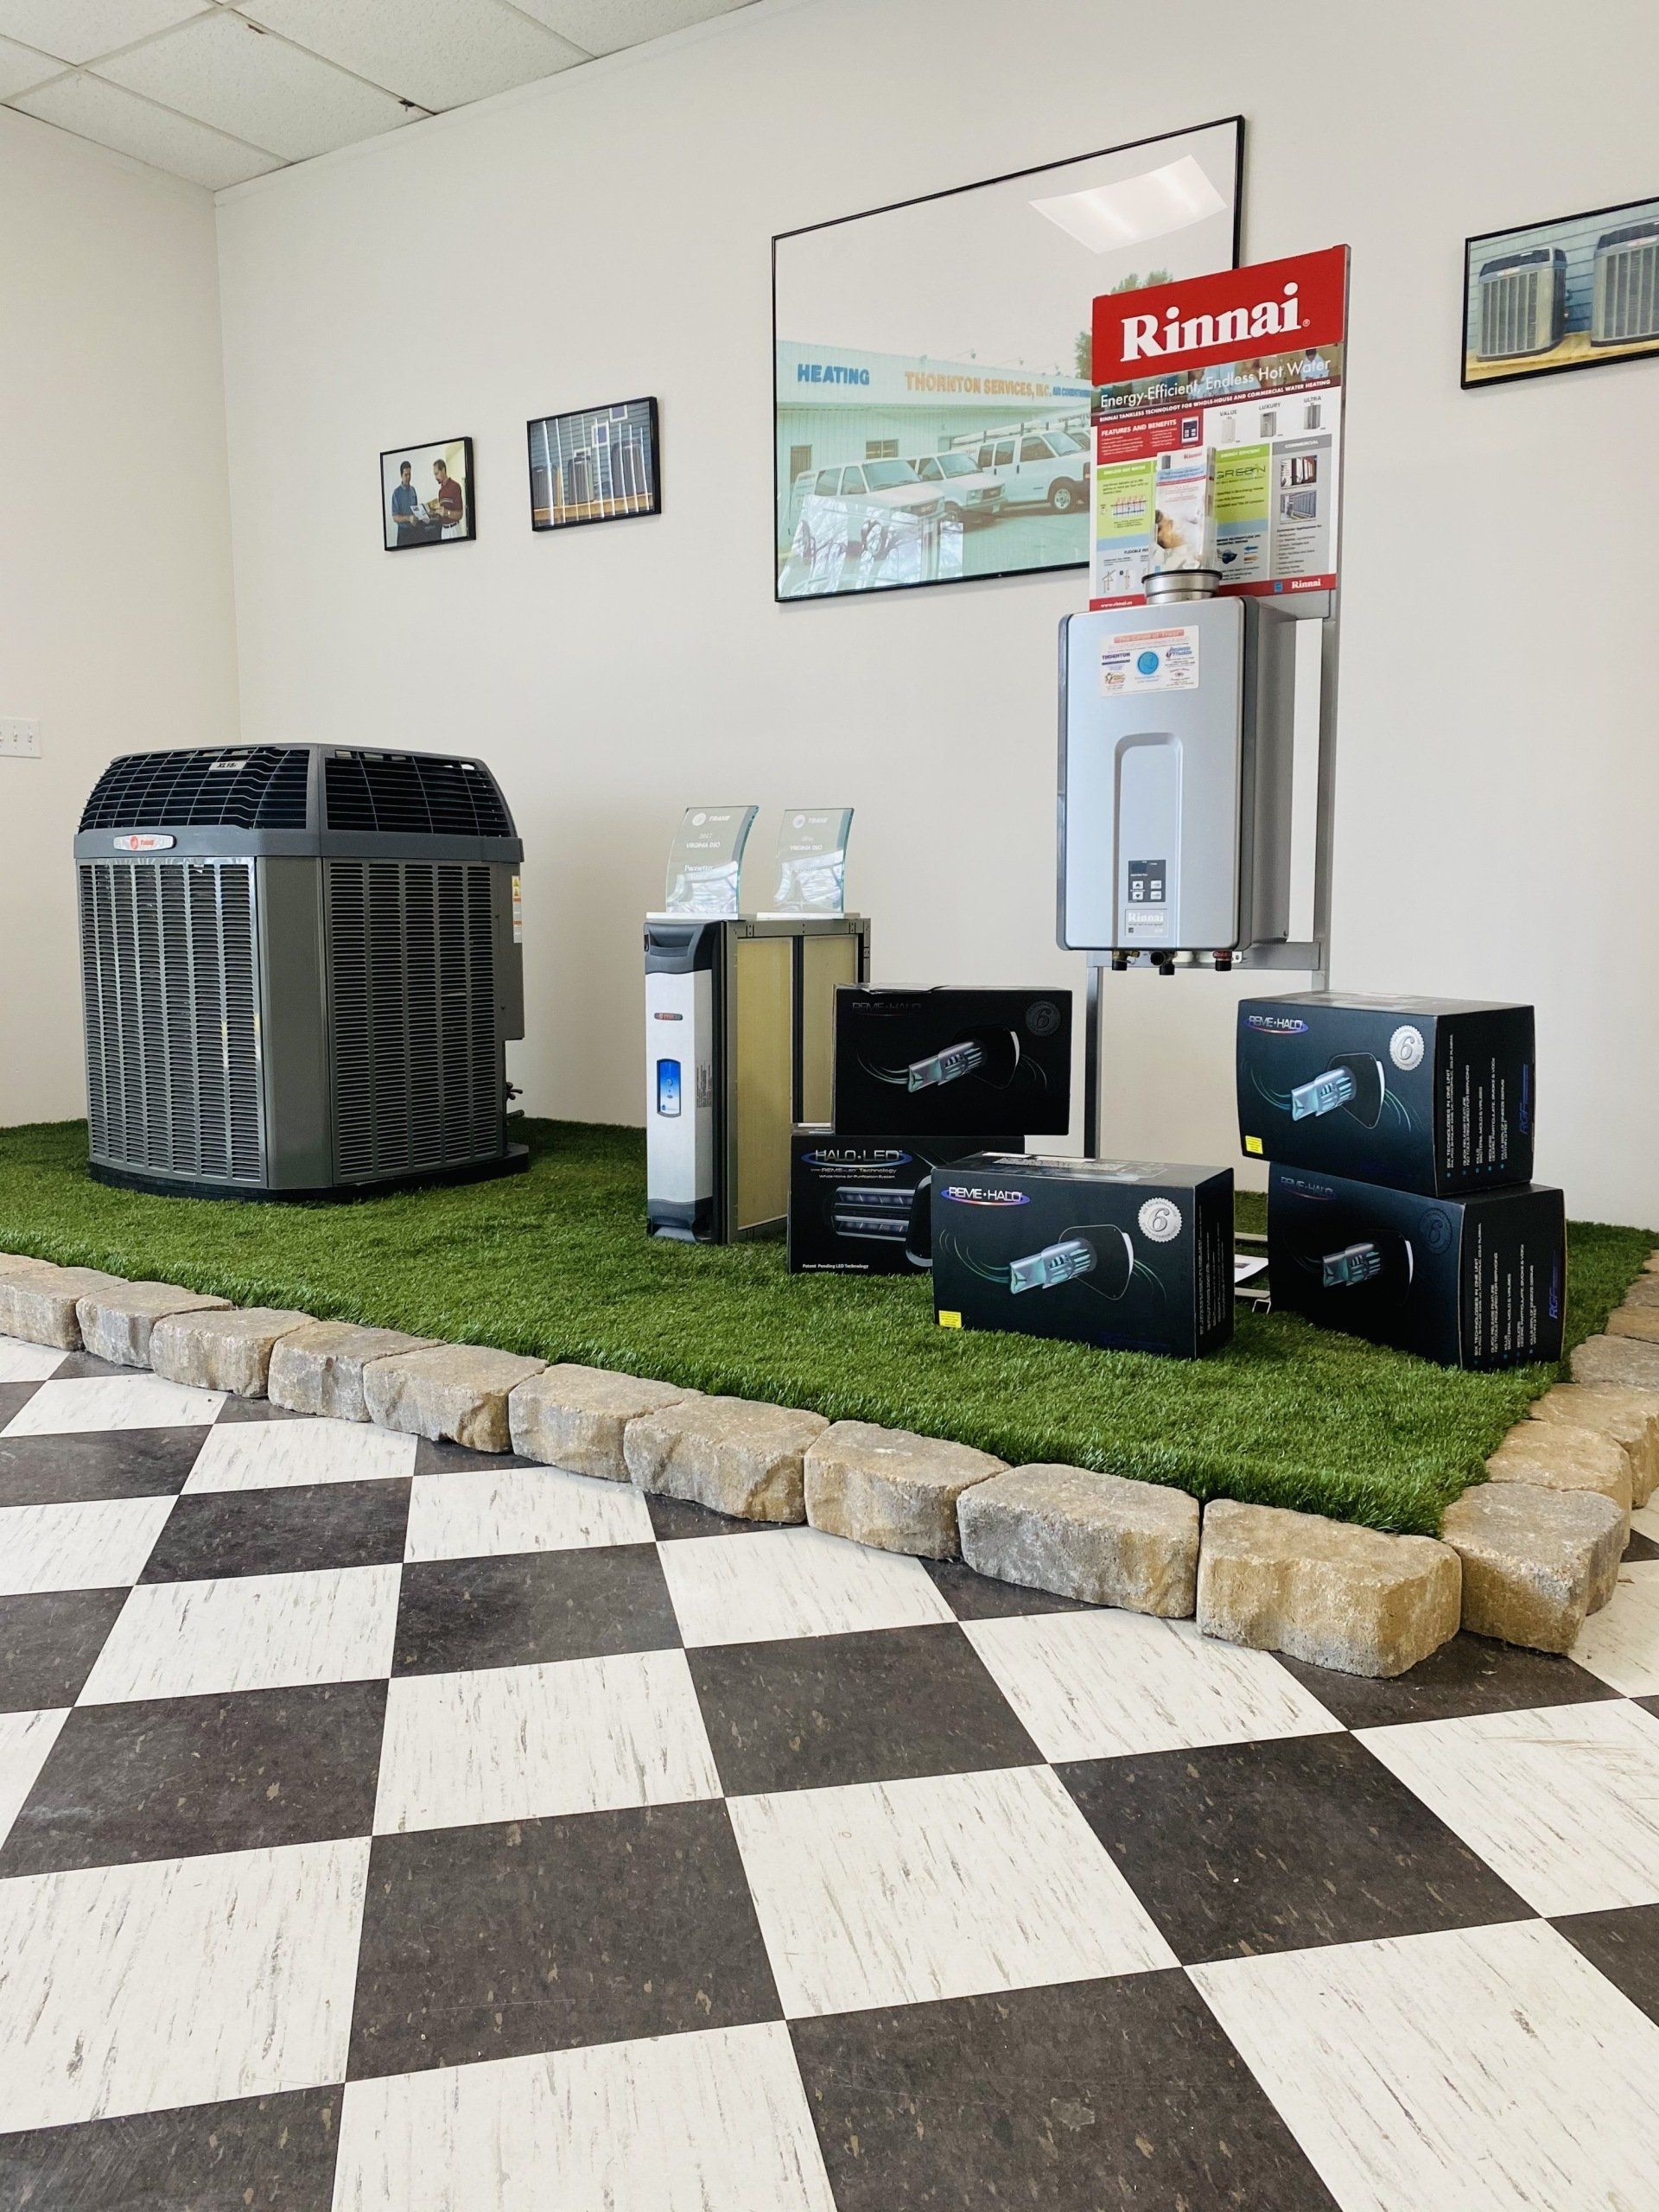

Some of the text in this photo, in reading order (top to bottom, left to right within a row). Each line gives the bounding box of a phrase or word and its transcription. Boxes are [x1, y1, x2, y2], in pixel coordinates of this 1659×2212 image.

[1120, 282, 1301, 362] Rinnai
[798, 364, 870, 385] HEATING
[905, 371, 982, 394] THORNTON
[1100, 380, 1202, 408] Energy-Efficient,
[1205, 372, 1255, 391] Endless
[1259, 366, 1284, 381] Hot
[1287, 359, 1331, 376] Water
[1119, 410, 1145, 419] TANKLESS
[1145, 404, 1181, 416] TECHNOLOGY
[1193, 396, 1232, 407] WHOLE-HOUSE
[1247, 387, 1284, 398] COMMERCIAL
[1305, 379, 1331, 388] HEATING
[1258, 402, 1281, 410] LUXURY
[1101, 426, 1131, 436] FEATURES
[1147, 418, 1178, 429] BENEFITS
[1292, 578, 1321, 589] Rinnai
[1128, 912, 1164, 922] Rinnai
[1399, 1036, 1415, 1060] 6
[1151, 1207, 1170, 1232] 6
